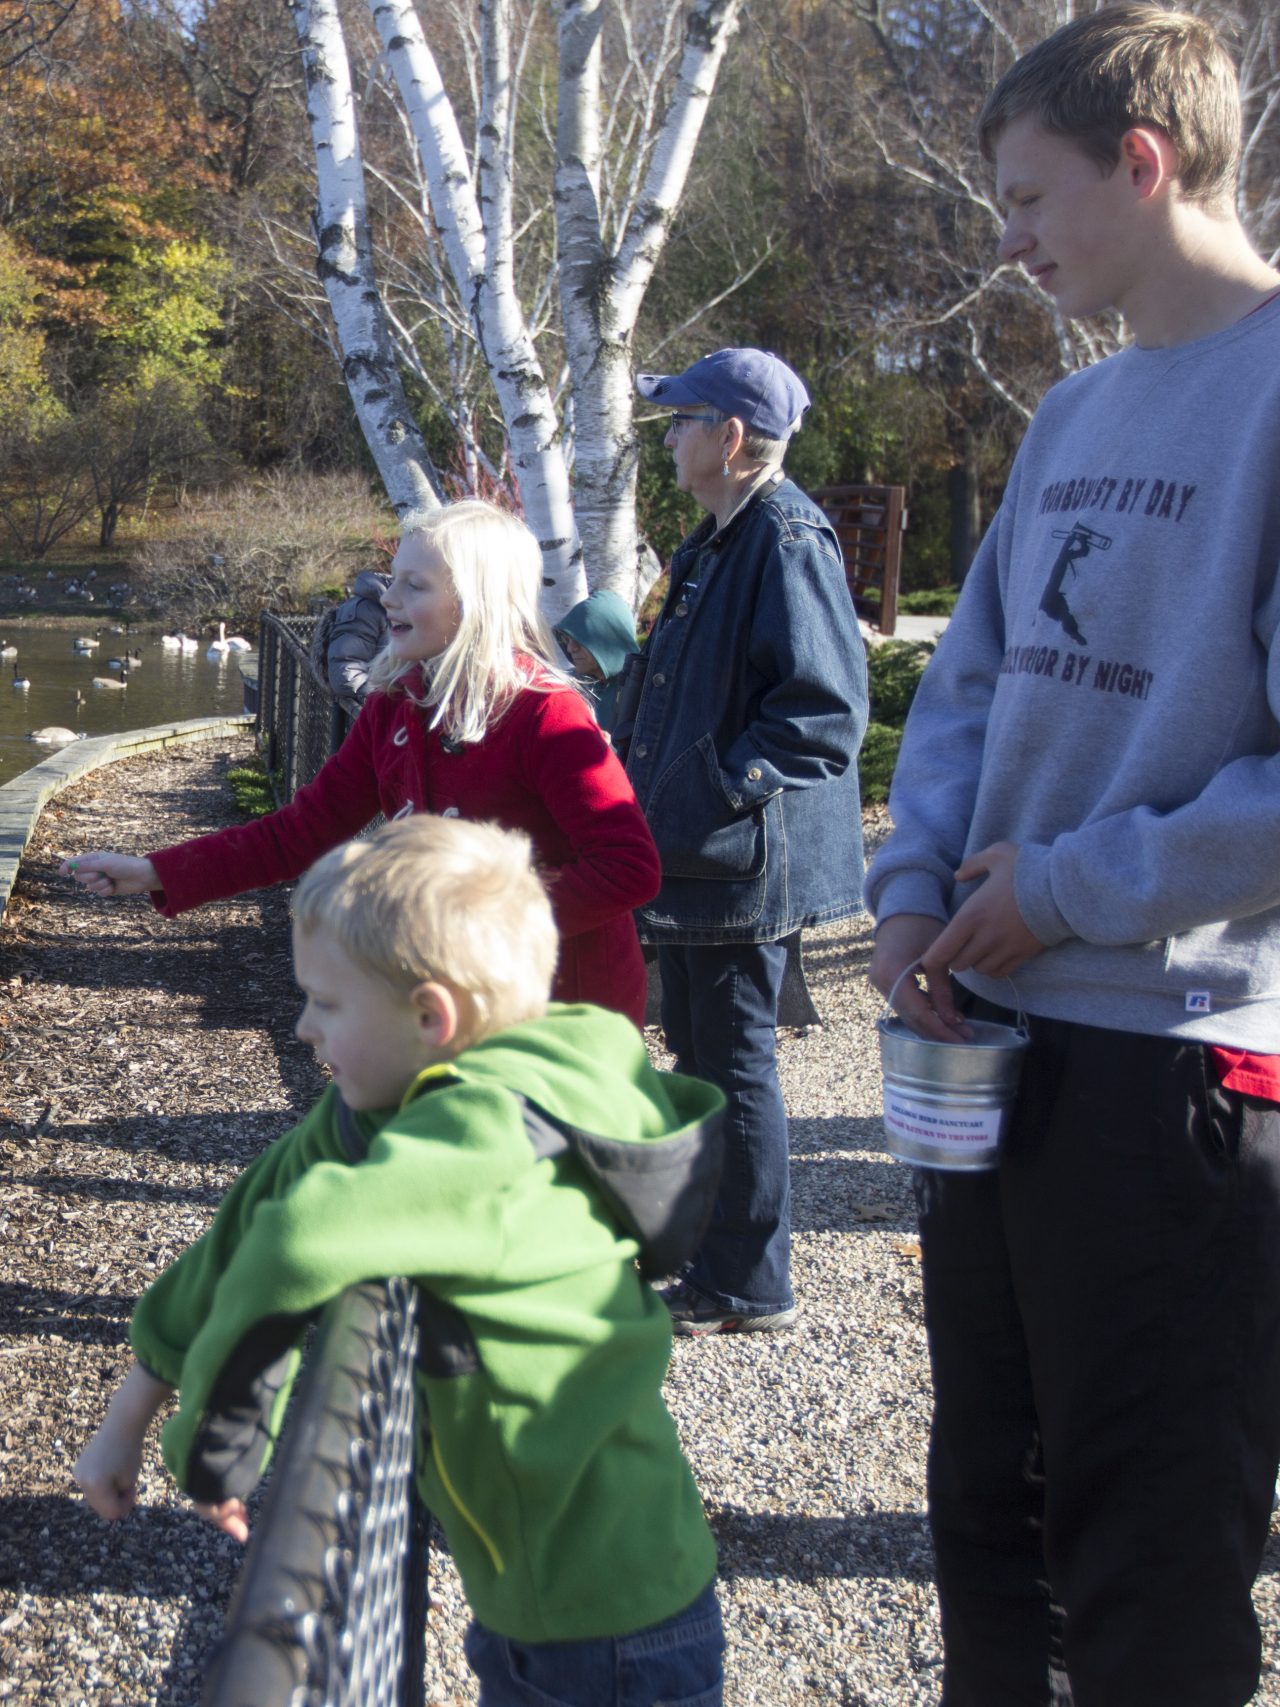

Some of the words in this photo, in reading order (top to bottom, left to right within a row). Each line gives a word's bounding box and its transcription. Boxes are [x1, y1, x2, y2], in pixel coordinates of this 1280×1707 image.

[1117, 478, 1146, 514] BY
[1145, 479, 1197, 522] DAY
[1061, 652, 1091, 686] BY
[1093, 660, 1155, 701] NIGHT
